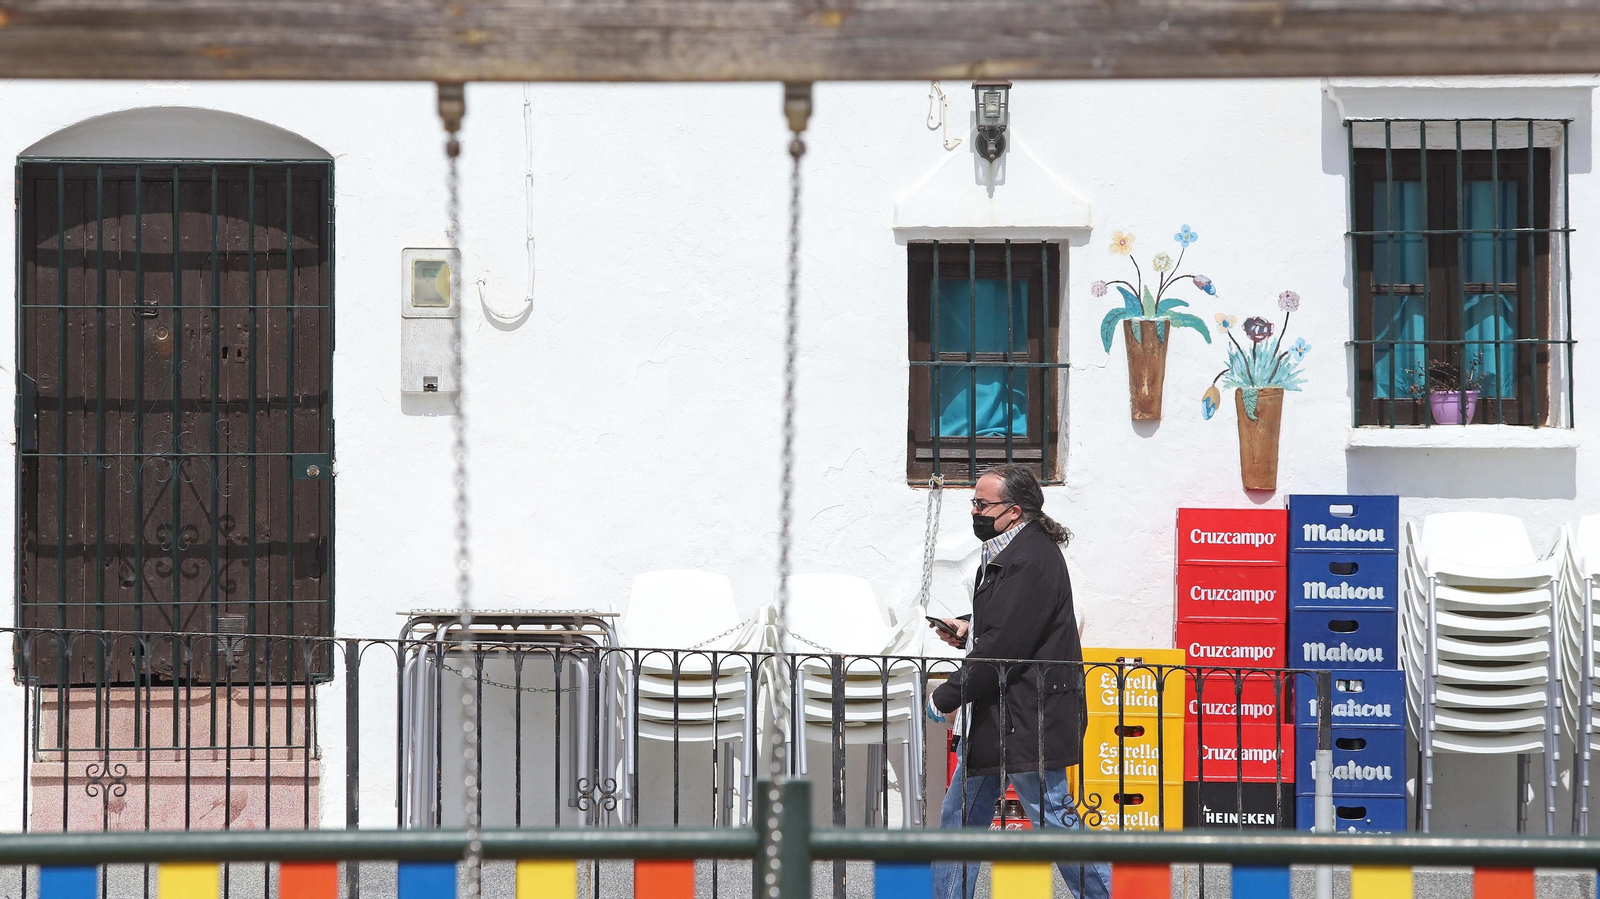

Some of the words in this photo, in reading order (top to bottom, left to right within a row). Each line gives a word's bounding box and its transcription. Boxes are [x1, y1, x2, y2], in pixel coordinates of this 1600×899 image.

[1190, 528, 1275, 547] Cruzcampo
[1302, 523, 1385, 542] Mahou
[1190, 585, 1275, 604] Cruzcampo
[1302, 581, 1385, 600] Mahou
[1189, 642, 1274, 661] Cruzcampo
[1302, 641, 1385, 663] Mahou
[1099, 672, 1160, 690] Esrella
[1188, 699, 1273, 719] Cruzcampo
[1098, 742, 1160, 760] Esrella
[1310, 759, 1393, 781] ahou
[1100, 809, 1160, 827] Esrella
[1205, 812, 1276, 825] HEINEKEN
